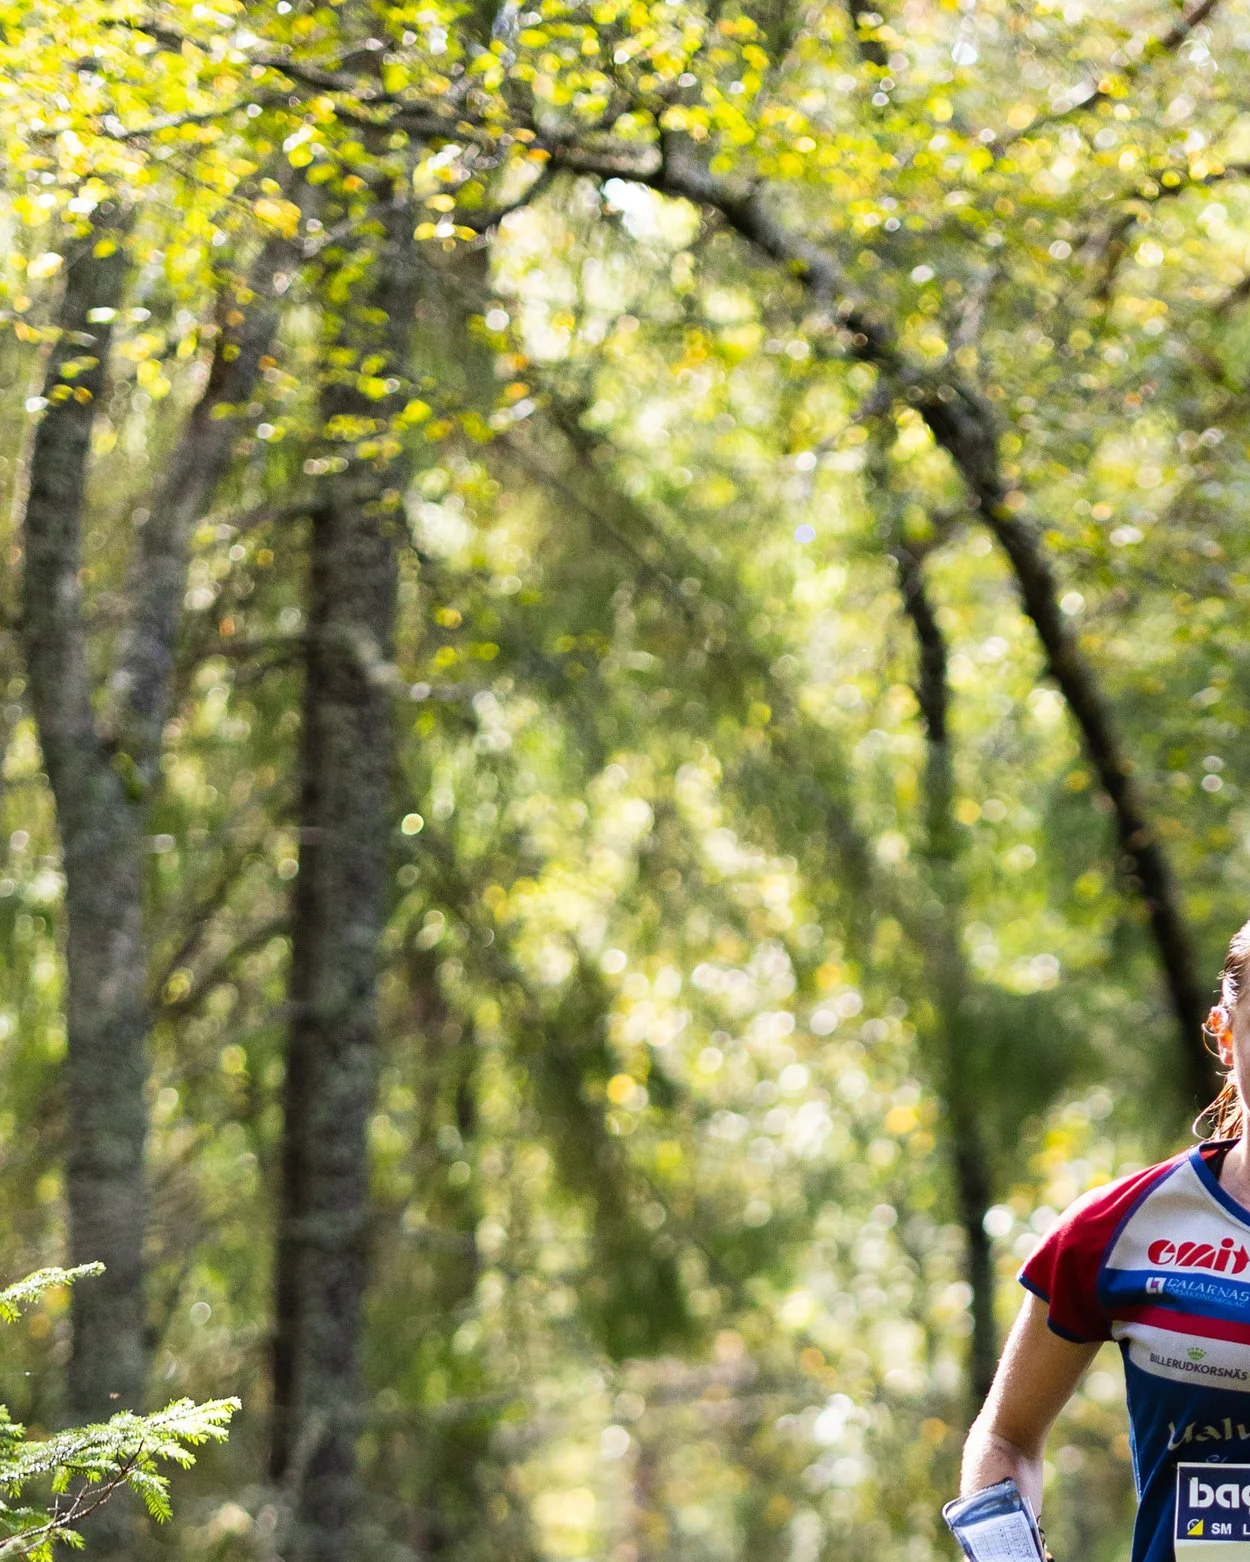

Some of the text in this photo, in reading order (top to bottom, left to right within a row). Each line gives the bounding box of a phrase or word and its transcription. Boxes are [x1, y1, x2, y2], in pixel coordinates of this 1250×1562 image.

[1147, 1237, 1250, 1275] emit
[1149, 1352, 1249, 1380] BILLERUDKORSNÄS
[1211, 1522, 1232, 1535] SM
